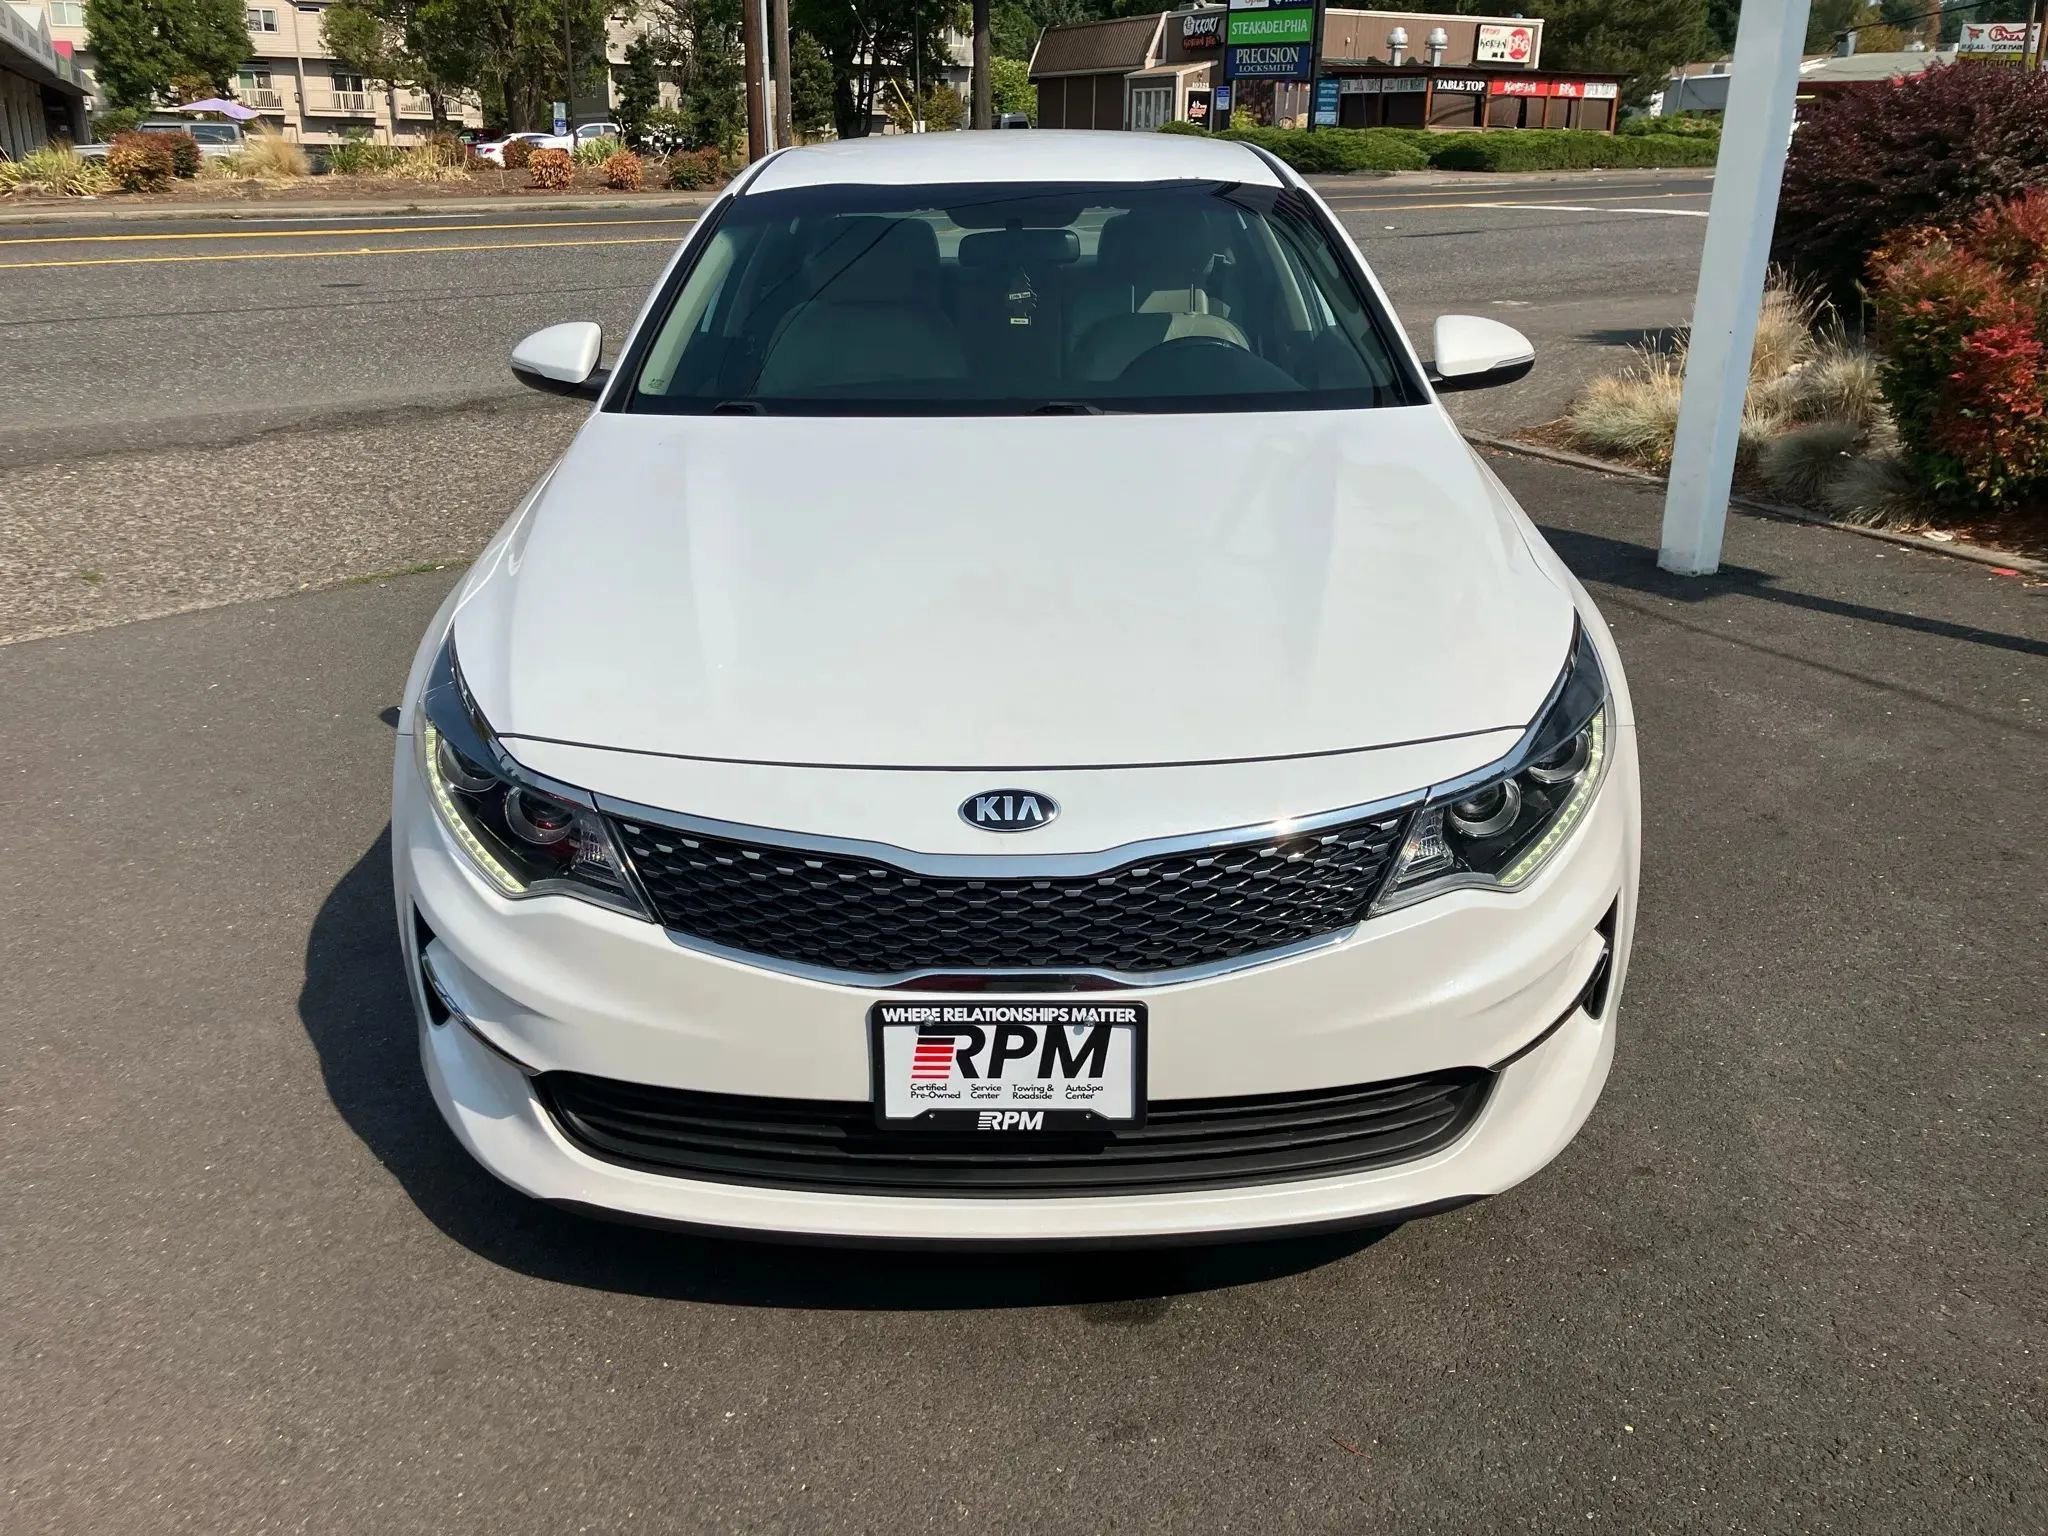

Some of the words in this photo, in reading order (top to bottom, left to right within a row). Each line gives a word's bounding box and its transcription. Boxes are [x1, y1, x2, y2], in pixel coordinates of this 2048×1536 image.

[1232, 19, 1308, 35] STEAKADELPHIA
[1236, 47, 1300, 64] PRECISION
[1239, 64, 1294, 72] LOCKSMITH
[1436, 80, 1465, 91] TABLE
[1465, 81, 1485, 91] TOP
[976, 796, 1043, 821] KIA
[882, 1008, 940, 1022] WHERE
[944, 1008, 1069, 1022] RELATIONSHIPS
[1071, 1008, 1137, 1022] MATTER
[911, 1025, 1111, 1079] RPM
[910, 1083, 947, 1091] Certified
[1012, 1084, 1045, 1093] Towing
[1047, 1084, 1055, 1092] &
[1065, 1084, 1103, 1093] AutoSpa
[910, 1091, 960, 1099] Pre-Owned
[970, 1091, 1000, 1099] Center
[1012, 1092, 1053, 1100] Roadside
[1065, 1092, 1095, 1100] Center
[977, 1111, 1044, 1130] RPM
